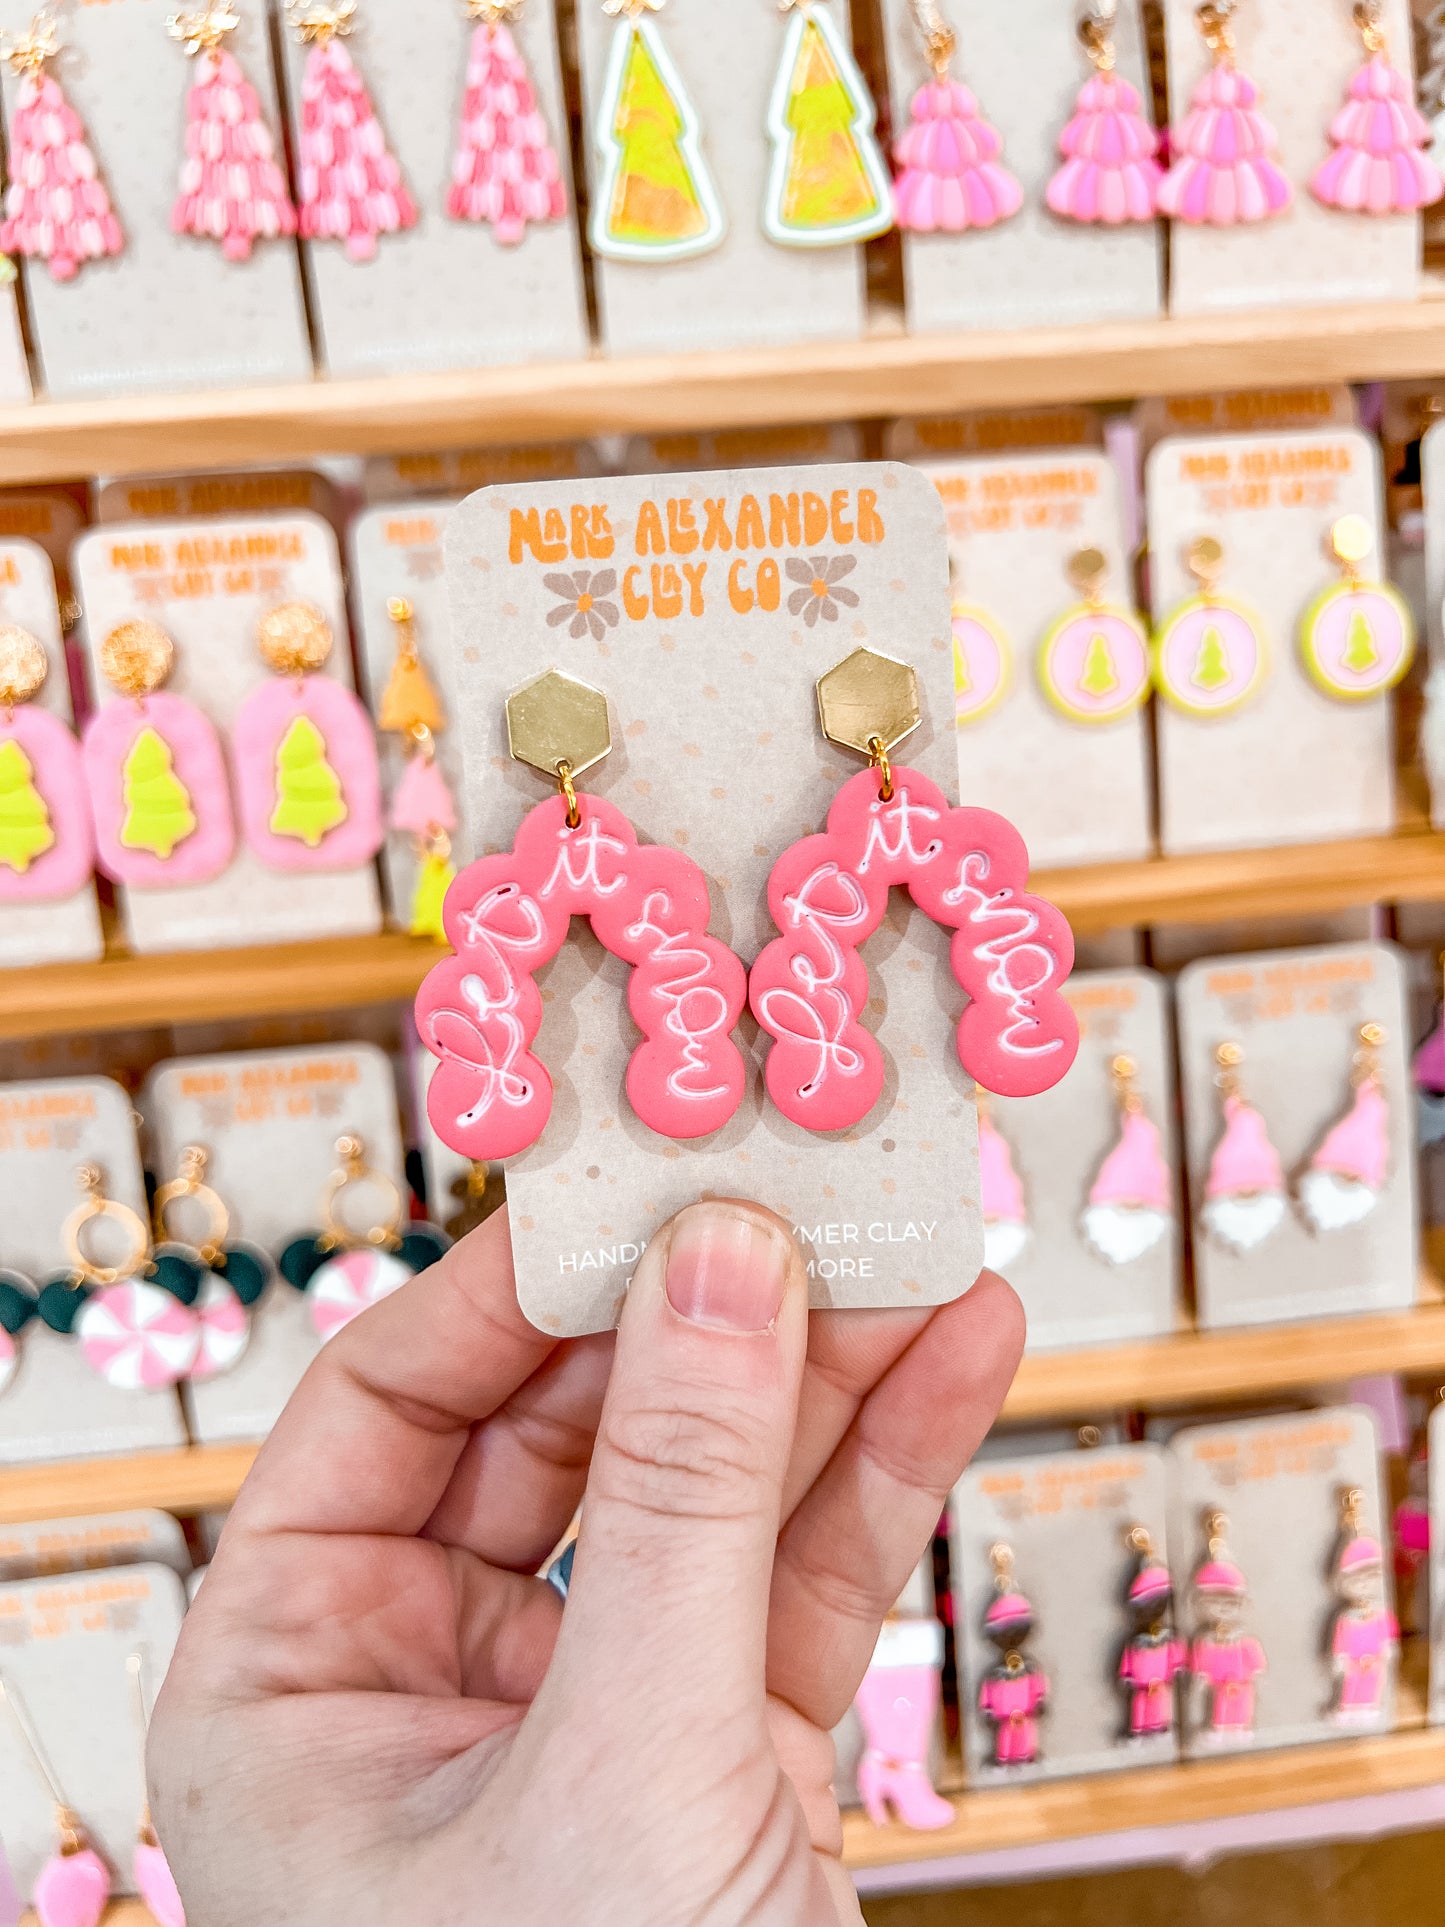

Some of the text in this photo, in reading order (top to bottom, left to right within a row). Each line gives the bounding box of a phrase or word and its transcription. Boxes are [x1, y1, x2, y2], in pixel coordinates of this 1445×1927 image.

[509, 504, 616, 564] MARK
[635, 488, 885, 557] ALEXANDER
[622, 557, 781, 621] CLAY CO
[539, 817, 627, 899] it
[628, 890, 730, 1099] snow
[857, 786, 942, 875] it
[943, 849, 1064, 1057] snow
[558, 1240, 648, 1275] HAND
[867, 1220, 938, 1243] CLAY
